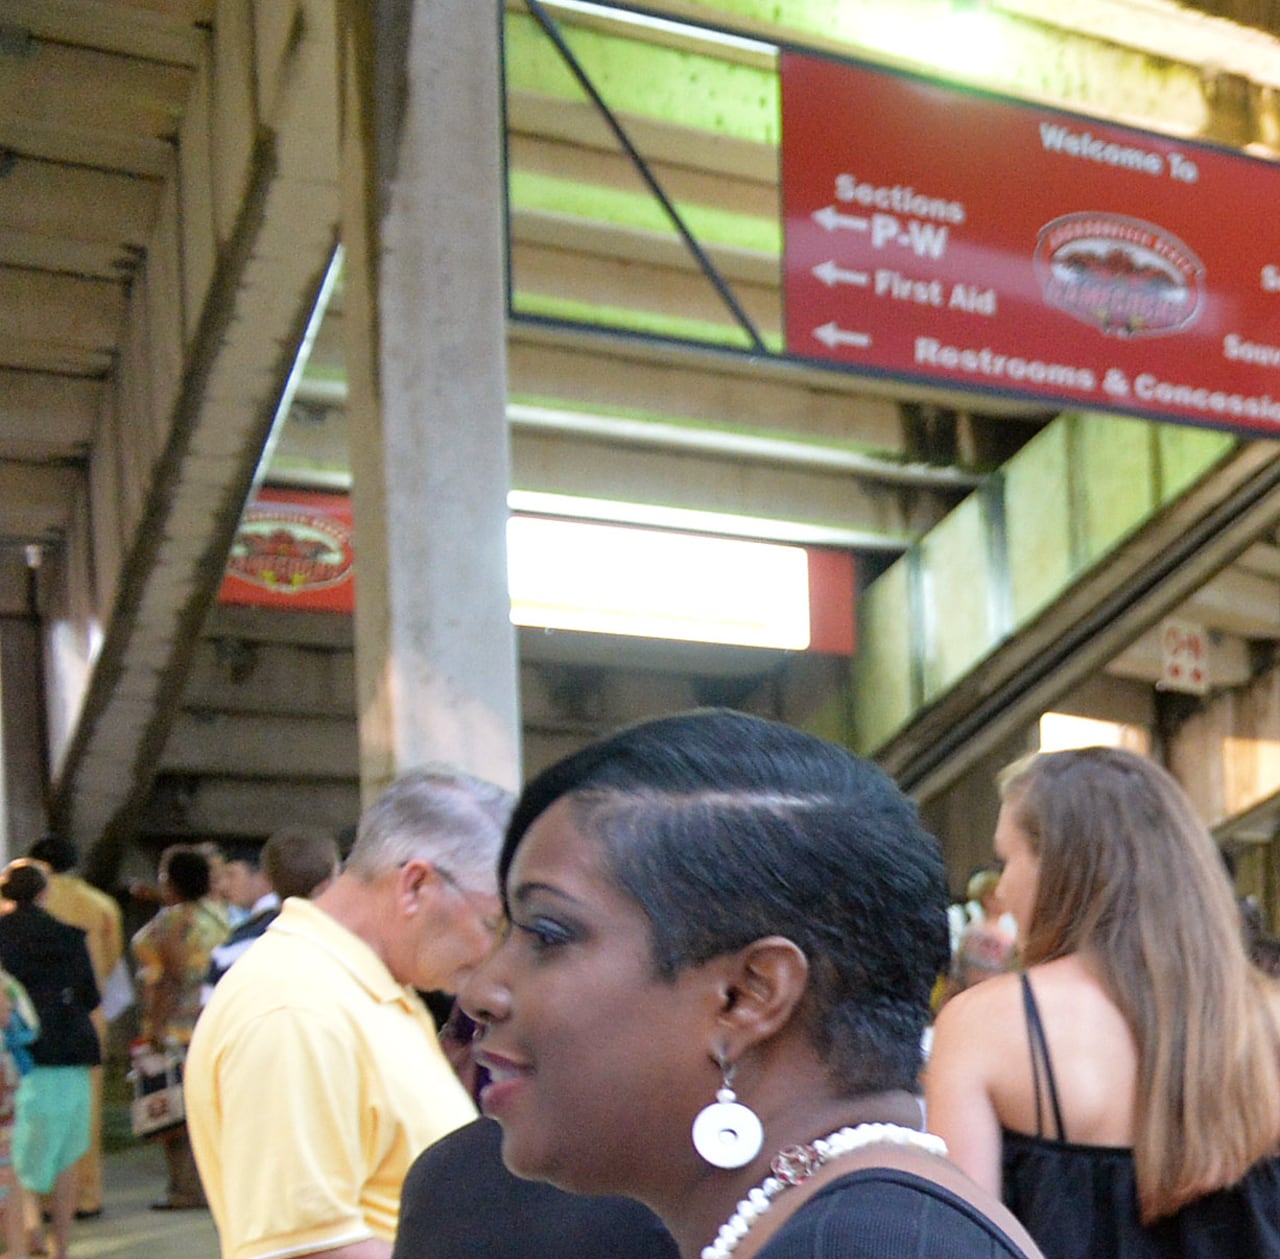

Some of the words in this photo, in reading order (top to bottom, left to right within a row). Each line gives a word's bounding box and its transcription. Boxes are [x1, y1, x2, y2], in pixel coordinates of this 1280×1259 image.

[1039, 121, 1164, 176] Welcome
[1167, 152, 1199, 184] To
[834, 172, 966, 225] Sections
[871, 212, 949, 259] P-W
[874, 268, 942, 308] First
[948, 283, 996, 316] Aid
[914, 336, 1096, 391] Restrooms
[1102, 368, 1130, 397] &
